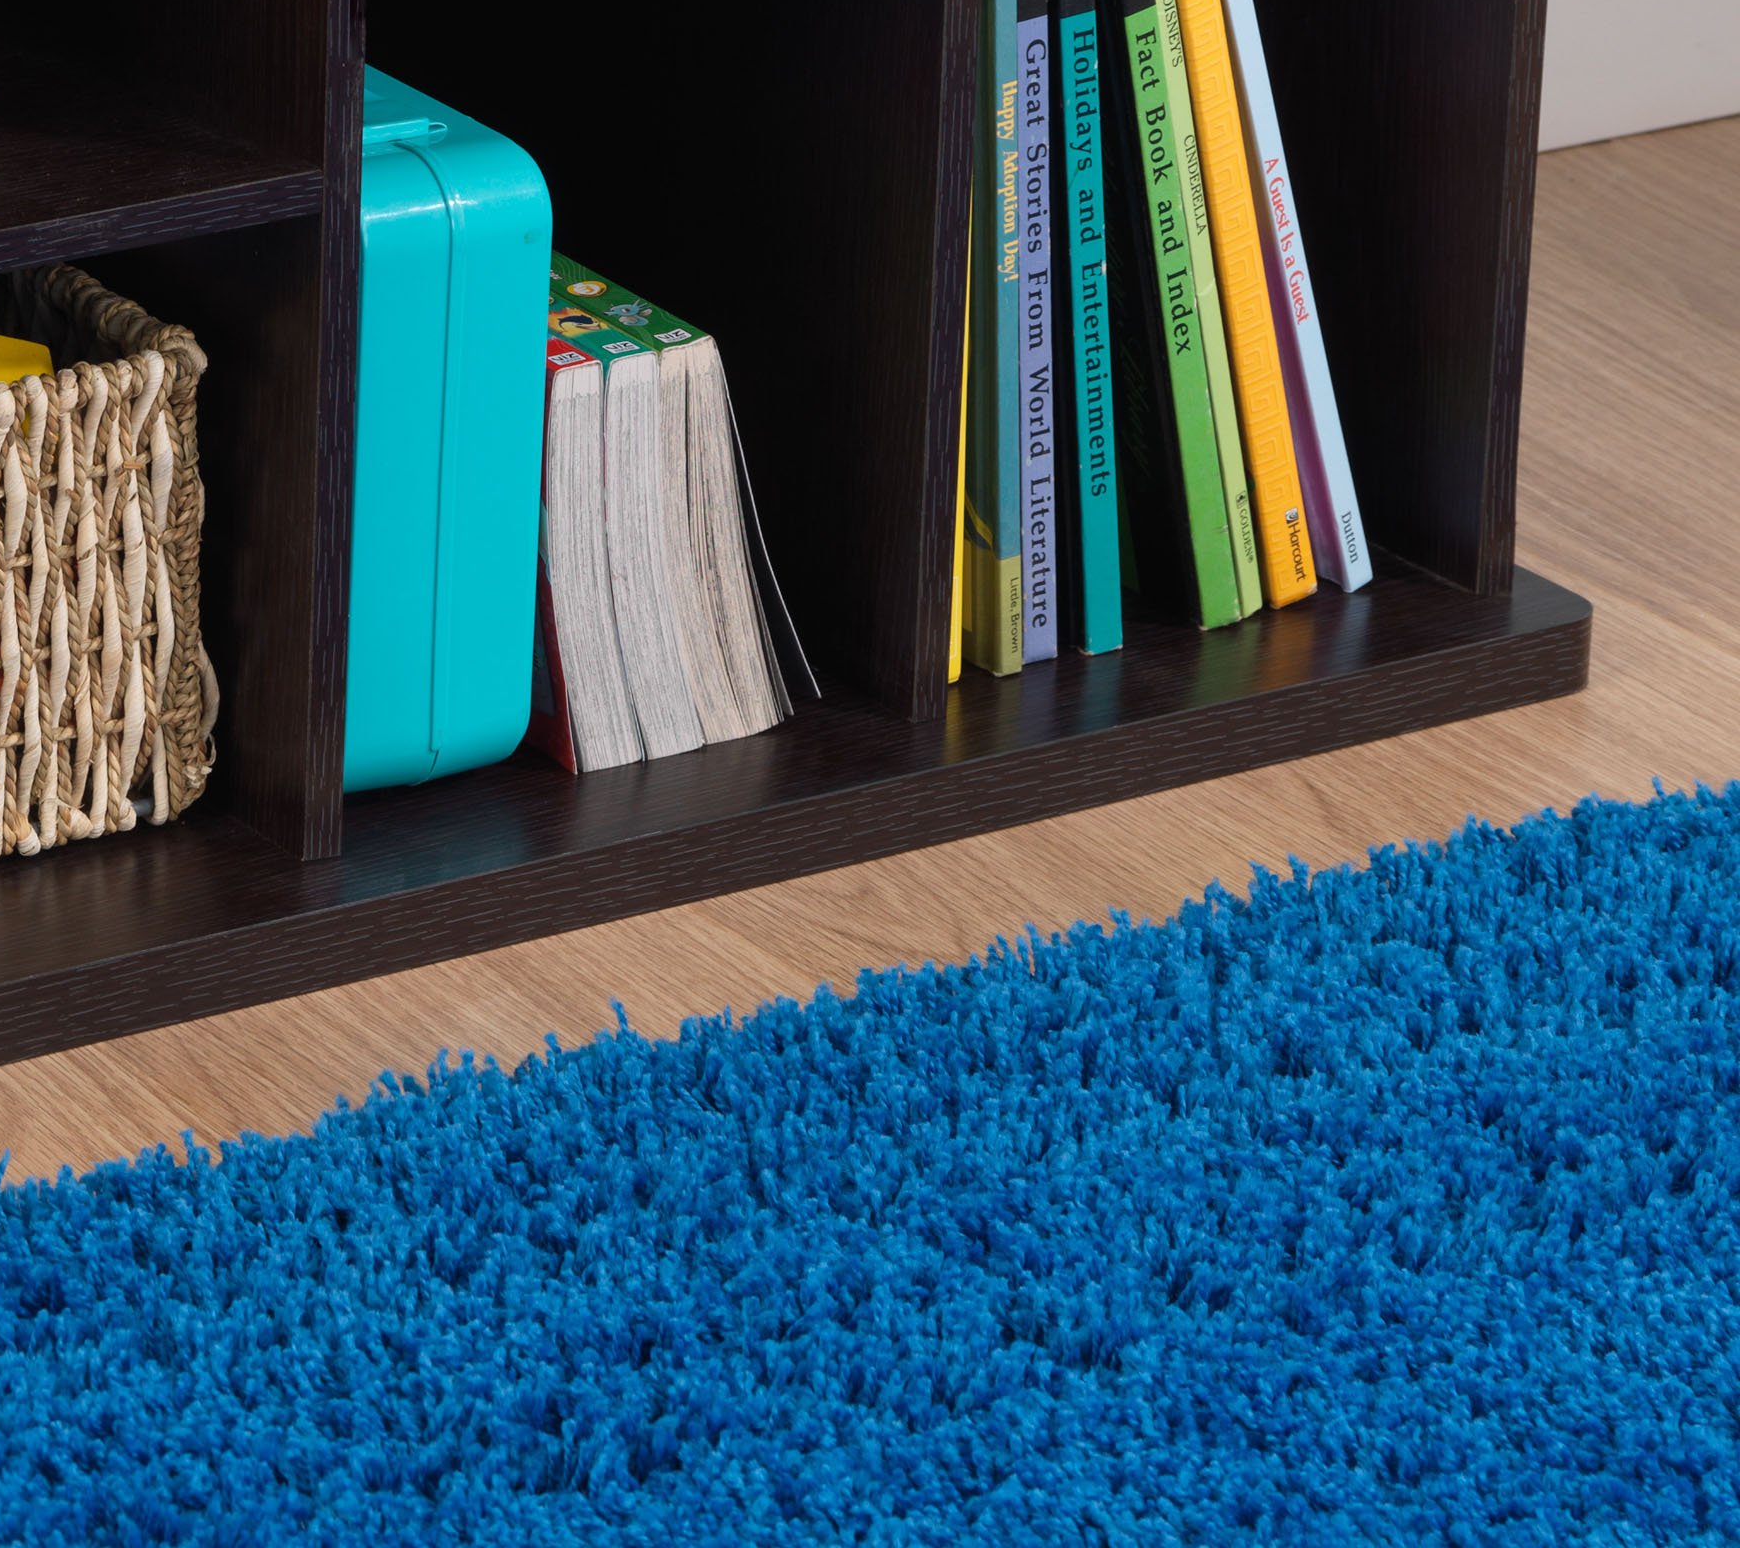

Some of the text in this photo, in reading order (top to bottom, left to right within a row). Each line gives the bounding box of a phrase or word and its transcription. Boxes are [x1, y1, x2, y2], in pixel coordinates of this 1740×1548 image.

[996, 80, 1019, 282] Happy Adoption Day!
[1070, 28, 1111, 497] Holidays and Entertainments
[1135, 27, 1193, 356] Fact Book and Index
[1183, 134, 1207, 236] CINDERELLA
[1264, 157, 1310, 325] A Guest Is a Guest
[1026, 39, 1051, 628] Great Stories From World Literature
[1288, 522, 1307, 582] Harcourt
[1341, 510, 1359, 564] Dutton
[1010, 613, 1020, 653] Brown
